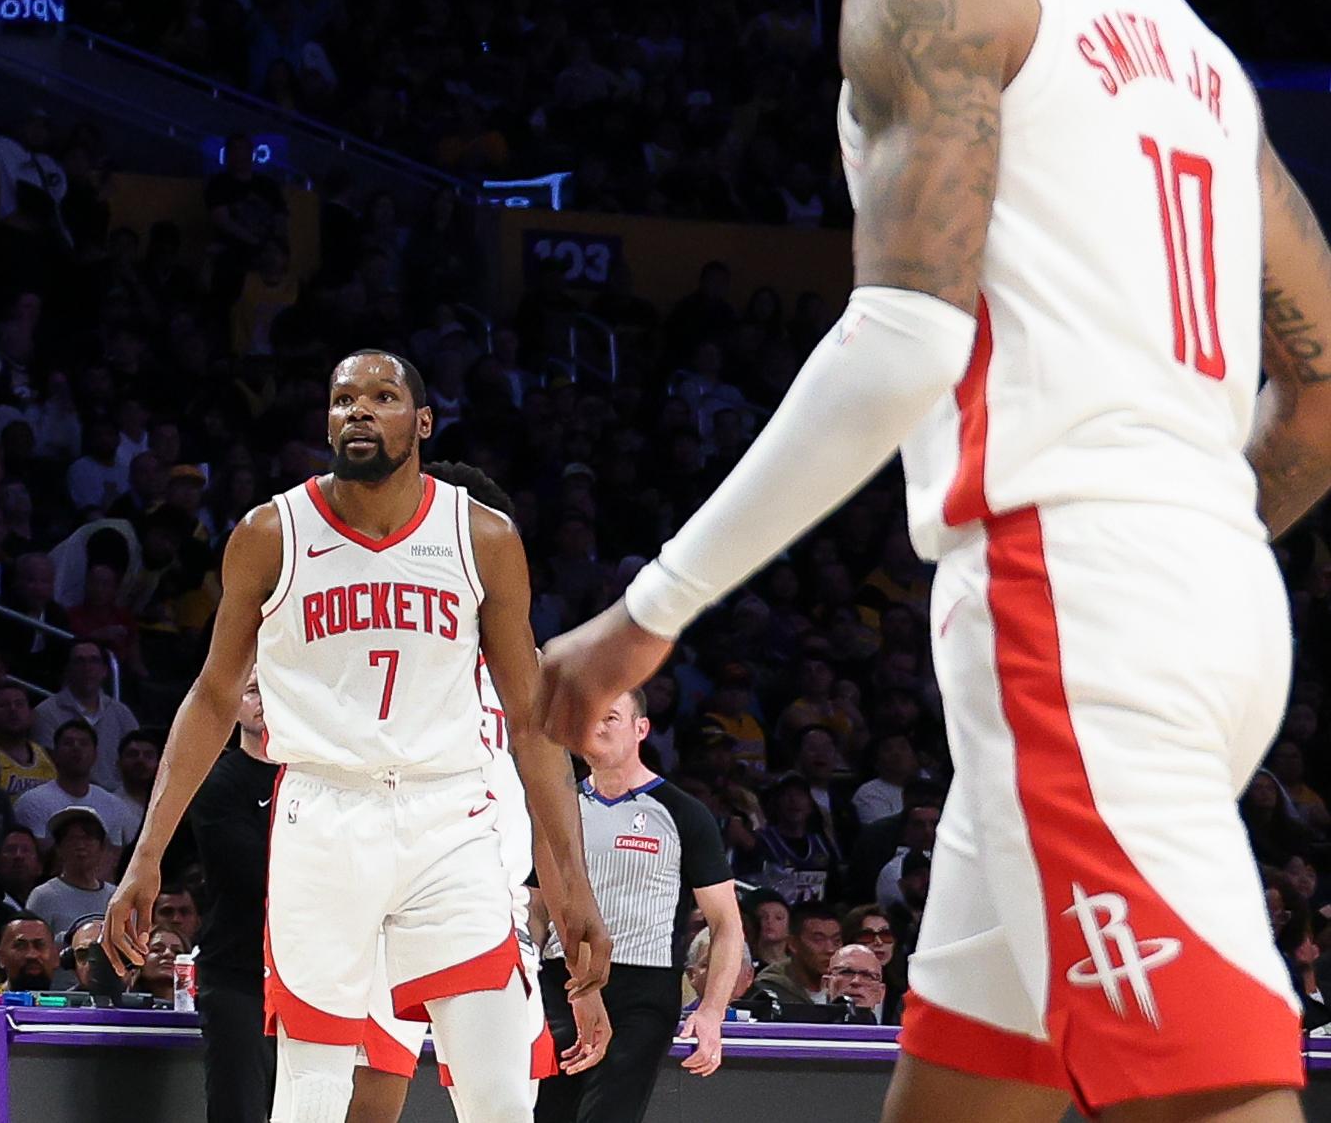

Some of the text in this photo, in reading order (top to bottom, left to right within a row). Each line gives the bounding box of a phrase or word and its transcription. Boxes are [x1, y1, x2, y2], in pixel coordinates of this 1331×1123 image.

[1076, 9, 1177, 97] SMITH
[1139, 133, 1226, 382] 10
[302, 581, 461, 645] ROCKETS
[368, 649, 400, 721] 7
[615, 837, 659, 851] Emirates
